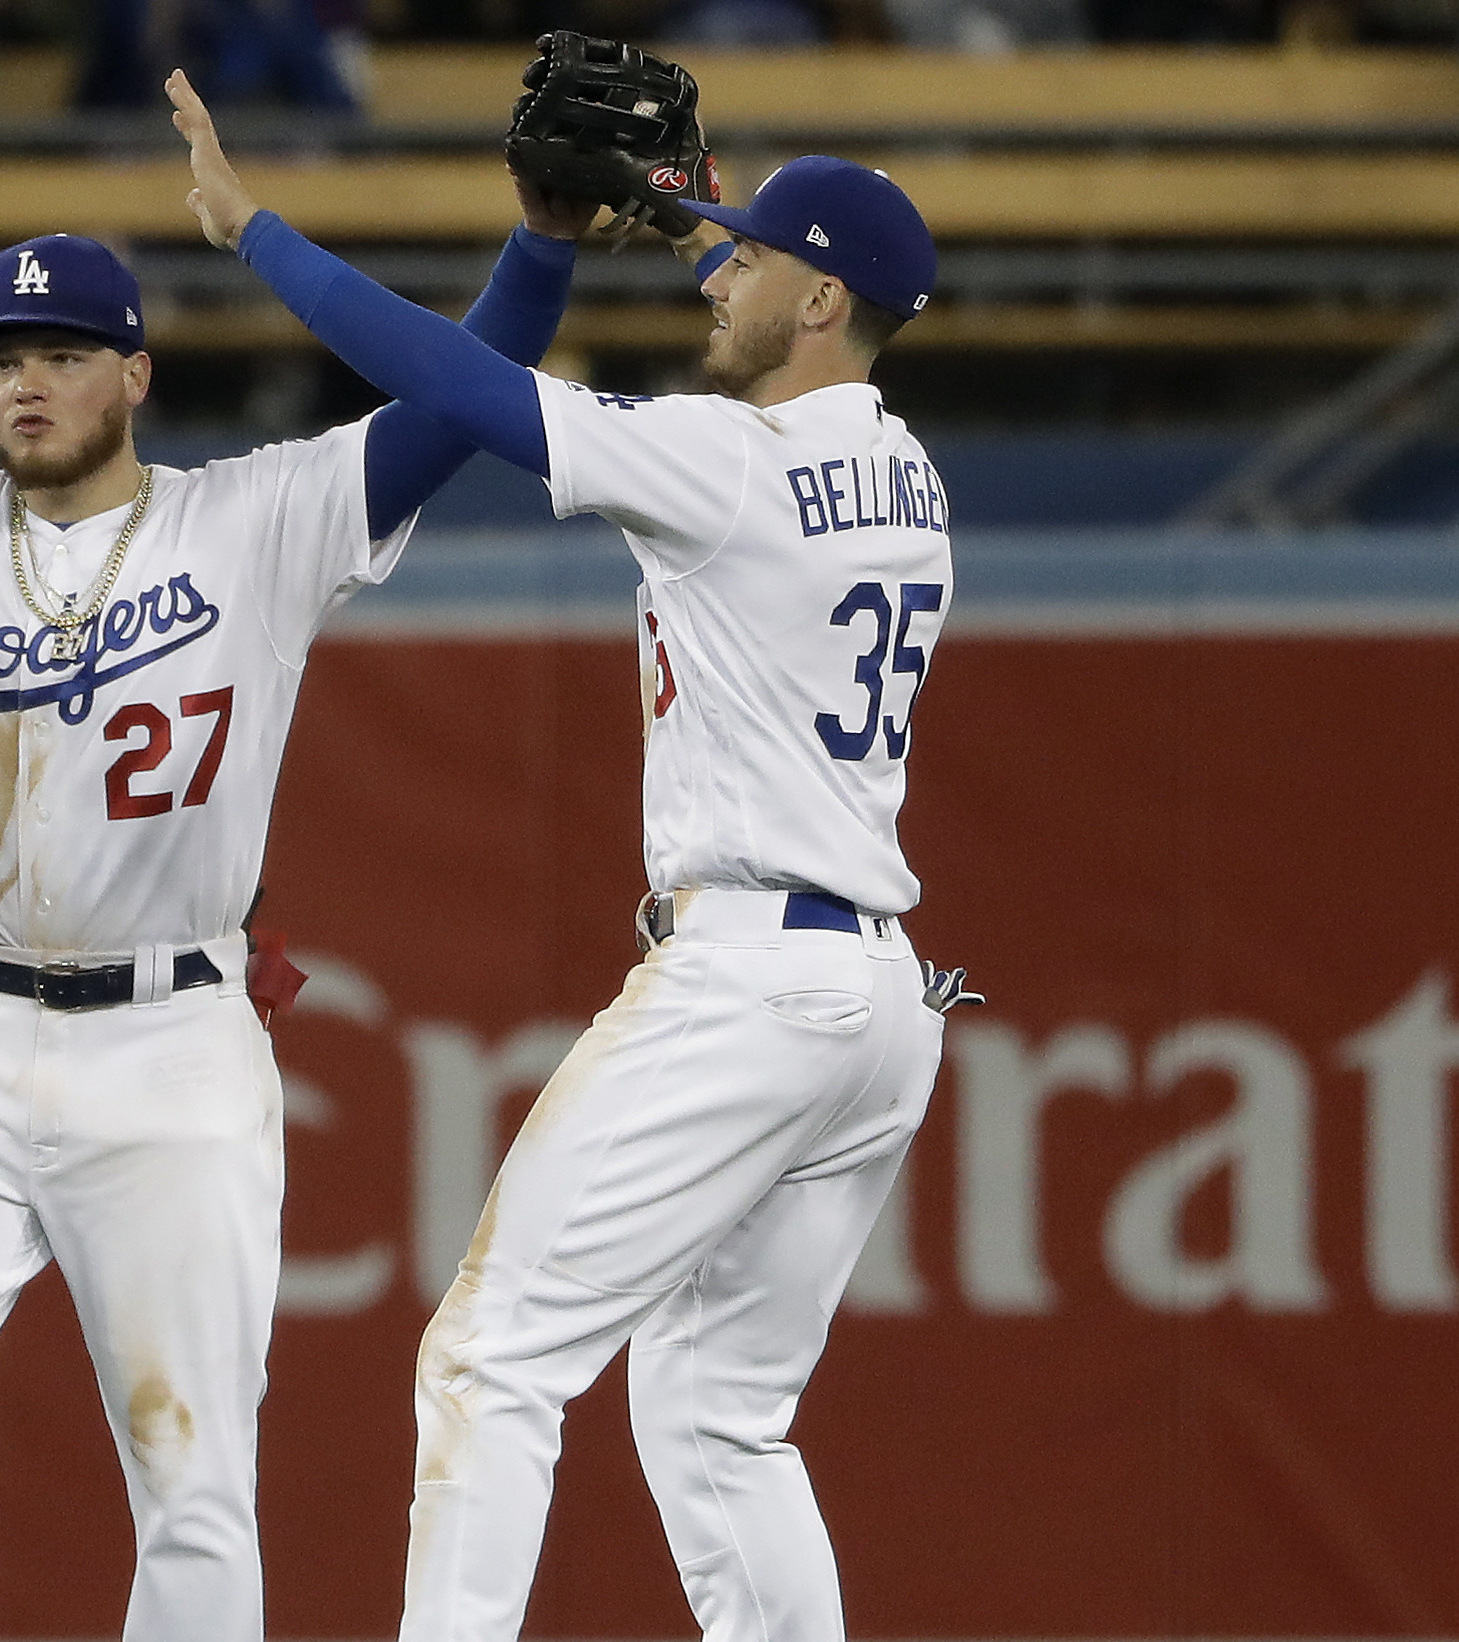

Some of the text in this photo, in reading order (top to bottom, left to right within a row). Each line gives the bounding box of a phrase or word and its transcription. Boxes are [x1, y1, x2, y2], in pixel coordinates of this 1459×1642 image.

[13, 250, 50, 294] LA
[786, 455, 950, 537] BELLINGE
[814, 582, 944, 762] 35
[103, 684, 235, 821] 27
